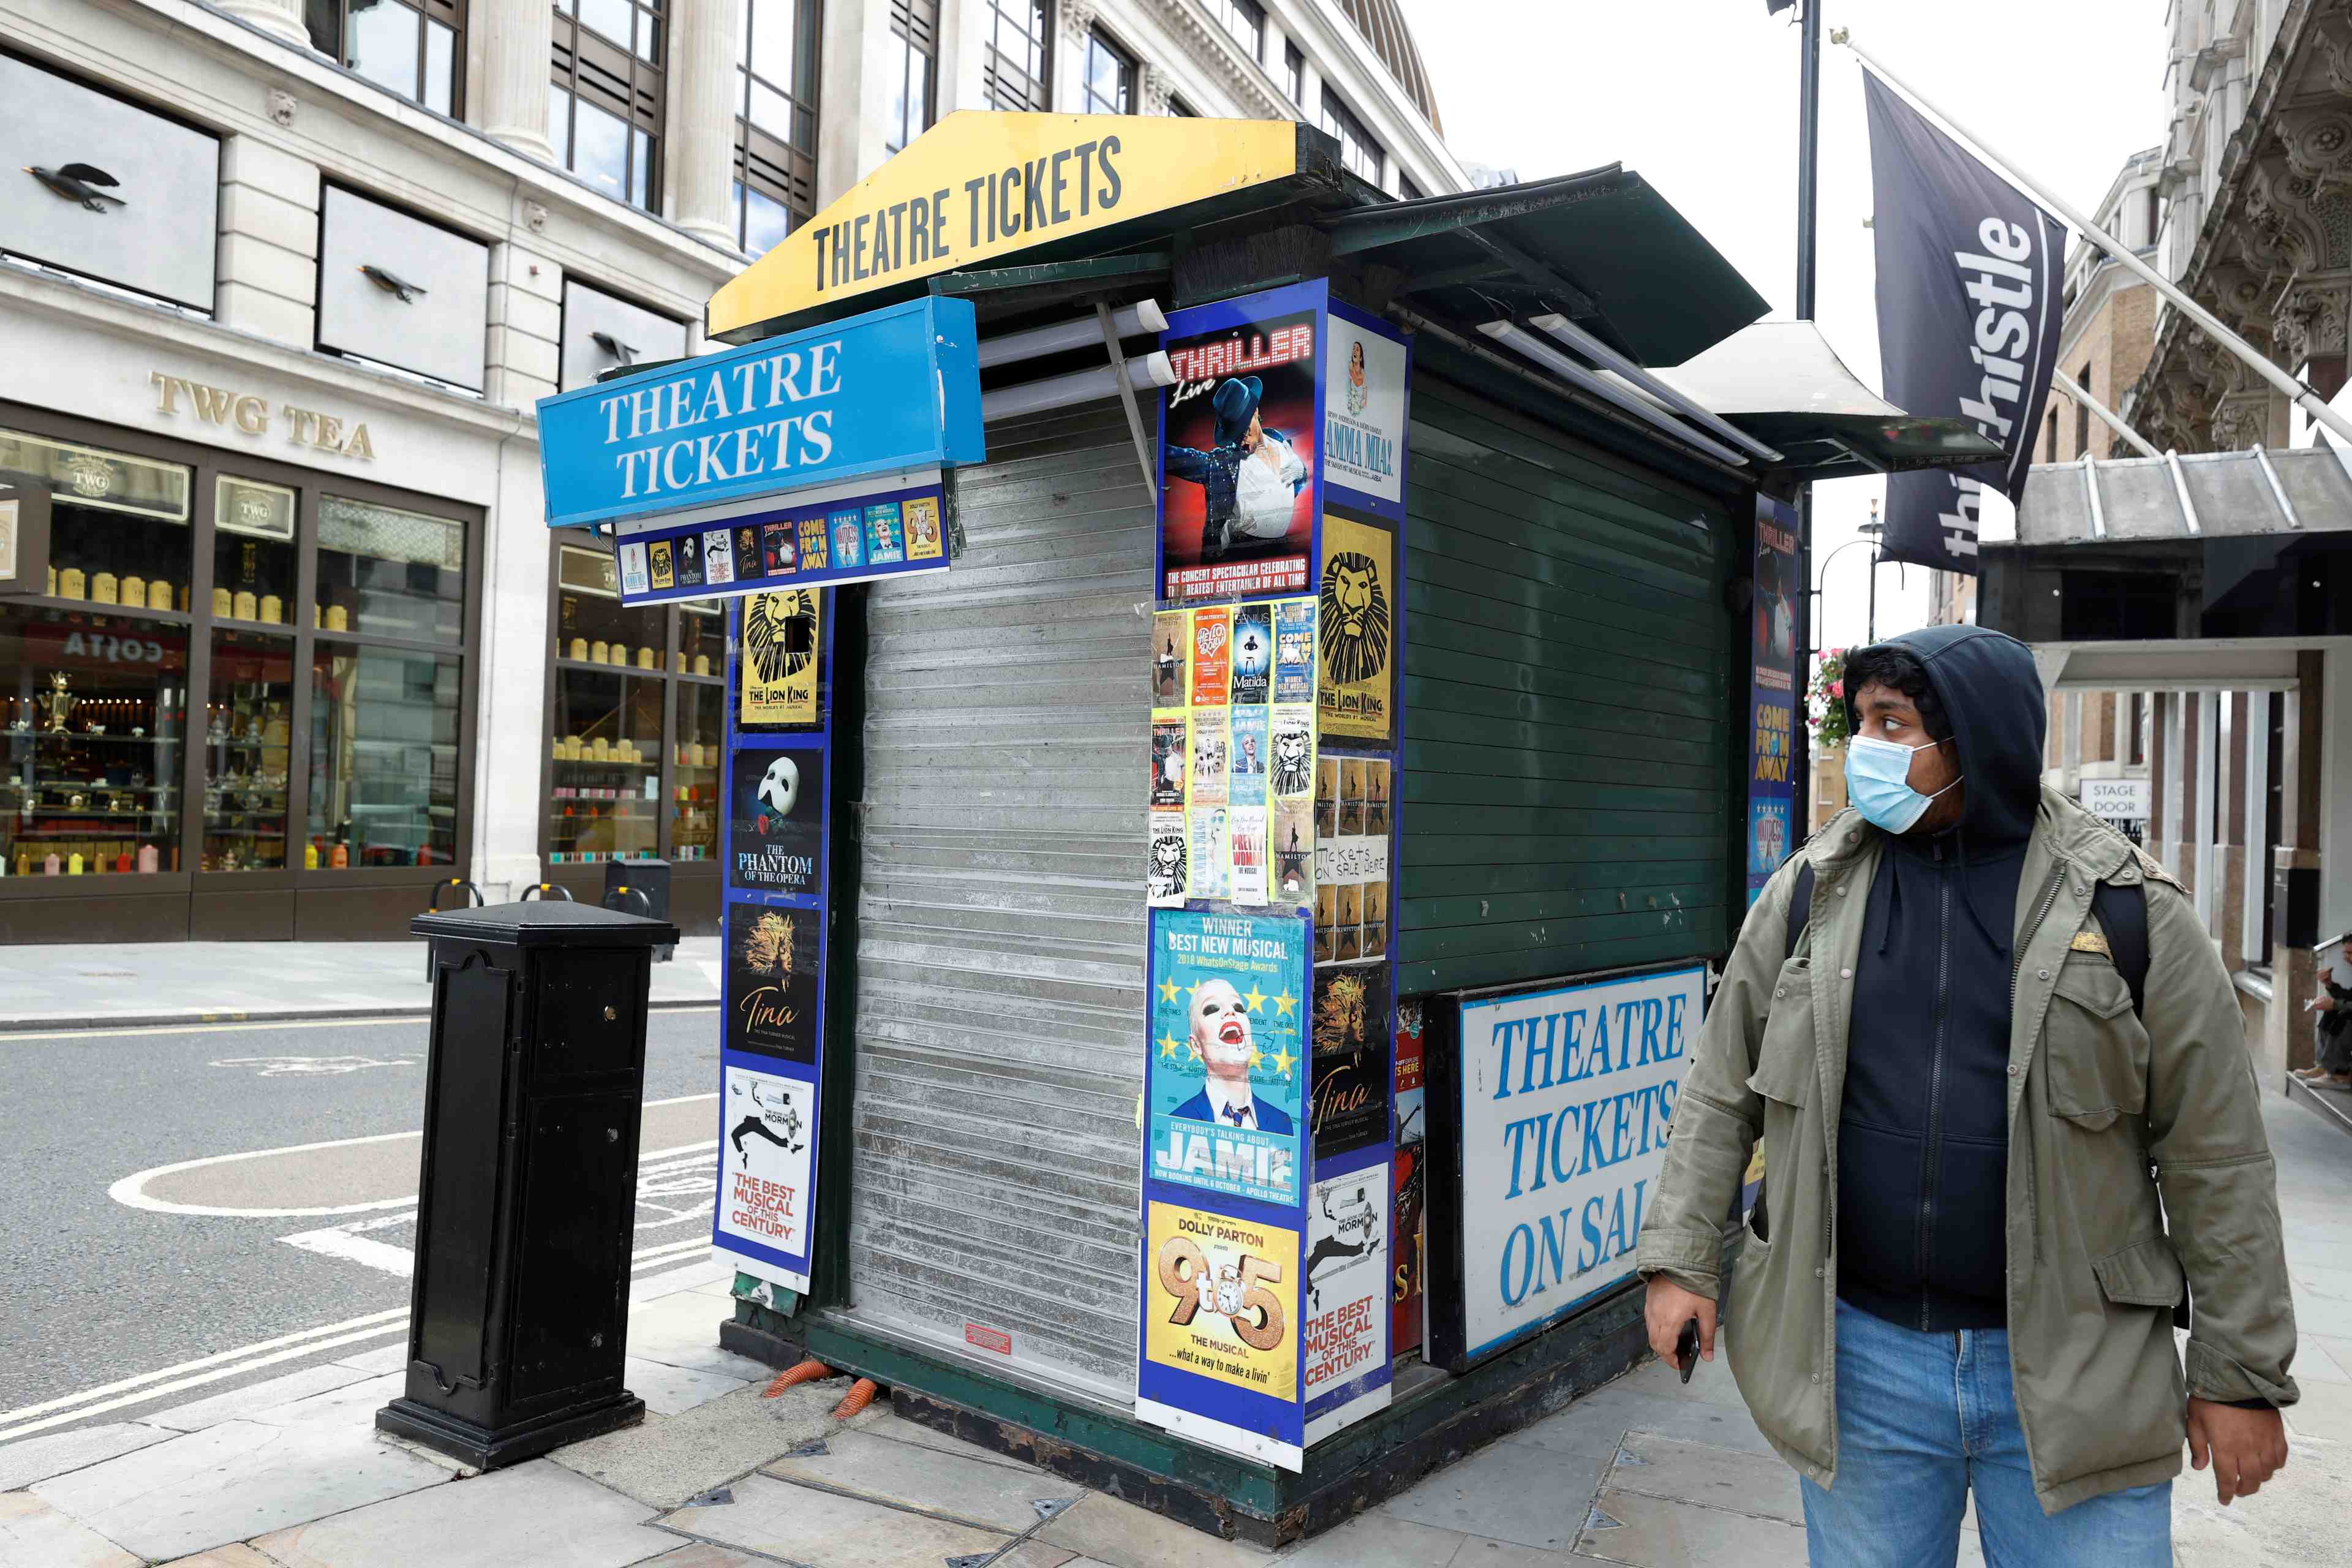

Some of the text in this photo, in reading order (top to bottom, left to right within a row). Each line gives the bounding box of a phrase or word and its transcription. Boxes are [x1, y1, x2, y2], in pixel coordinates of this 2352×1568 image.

[813, 135, 1122, 291] THEATRE TICKETS
[1170, 326, 1311, 382] THRILLER
[600, 340, 843, 445] THEATRE
[1169, 377, 1216, 409] Live
[149, 371, 376, 460] TWG TEA
[616, 411, 833, 500] TICKETS
[1324, 420, 1362, 467] AMMA
[74, 472, 108, 490] TWG
[241, 503, 270, 518] TWG
[763, 522, 793, 532] THRILLER
[798, 519, 826, 537] COME
[799, 535, 827, 554] FROM
[871, 549, 902, 562] JAMIE
[801, 552, 827, 570] AWAY
[1168, 558, 1306, 584] THE CONCERT SPECTACULAR CELEBRATING
[1263, 576, 1271, 589] OF
[1273, 574, 1286, 587] ALL
[1288, 573, 1305, 586] TIME
[1235, 612, 1269, 625] GENIUS
[1280, 632, 1312, 643] COME
[1234, 676, 1267, 688] Matilda
[750, 686, 809, 704] THE LION KING
[1321, 689, 1383, 714] THE LION KING
[1757, 704, 1789, 732] COME
[1755, 728, 1789, 757] FROM
[1755, 755, 1789, 782] AWAY
[2094, 785, 2136, 796] STAGE
[2095, 801, 2135, 812] DOOR
[766, 845, 784, 855] THE
[1233, 851, 1264, 866] WOMAN
[738, 853, 813, 875] PHANTOM
[1315, 858, 1384, 880] ON SALE HERE
[745, 870, 806, 885] OF THE OPERA
[1202, 917, 1253, 937] WINNER
[1169, 931, 1288, 960] BEST NEW MUSICAL
[1177, 954, 1278, 973] 2018 WhatsOnStage Awards
[740, 986, 801, 1033] Tina
[1491, 993, 1687, 1100] THEATRE
[1403, 1063, 1419, 1074] HERE
[1270, 1078, 1291, 1087] ATTITUDE
[1311, 1065, 1373, 1136] Tina
[765, 1111, 802, 1129] MORMON
[1170, 1121, 1270, 1147] EVERYBODY'S TALKING ABOUT
[1504, 1079, 1679, 1200] TICKETS
[1156, 1131, 1293, 1192] JAMIE
[762, 1180, 795, 1201] BEST
[1155, 1169, 1167, 1177] NOW
[1168, 1170, 1193, 1183] BOOKING
[1194, 1175, 1209, 1186] UNTIL
[1215, 1180, 1241, 1192] OCTOBER
[1246, 1185, 1268, 1198] APOLLO
[1269, 1189, 1294, 1203] THEATRE
[734, 1186, 794, 1217] MUSICAL
[747, 1205, 779, 1222] OF THIS
[1178, 1218, 1214, 1238] DOLLY
[1217, 1227, 1264, 1248] PARTON
[1338, 1211, 1378, 1235] MORMON
[1500, 1207, 1573, 1307] ON
[1577, 1179, 1648, 1275] SAL
[1338, 1295, 1373, 1326] BEST
[1190, 1334, 1249, 1359] THE MUSICAL
[1306, 1317, 1373, 1358] MUSICAL
[1321, 1336, 1357, 1362] OF THIS
[1201, 1357, 1215, 1371] way
[1216, 1360, 1224, 1371] to
[1225, 1362, 1245, 1378] make
